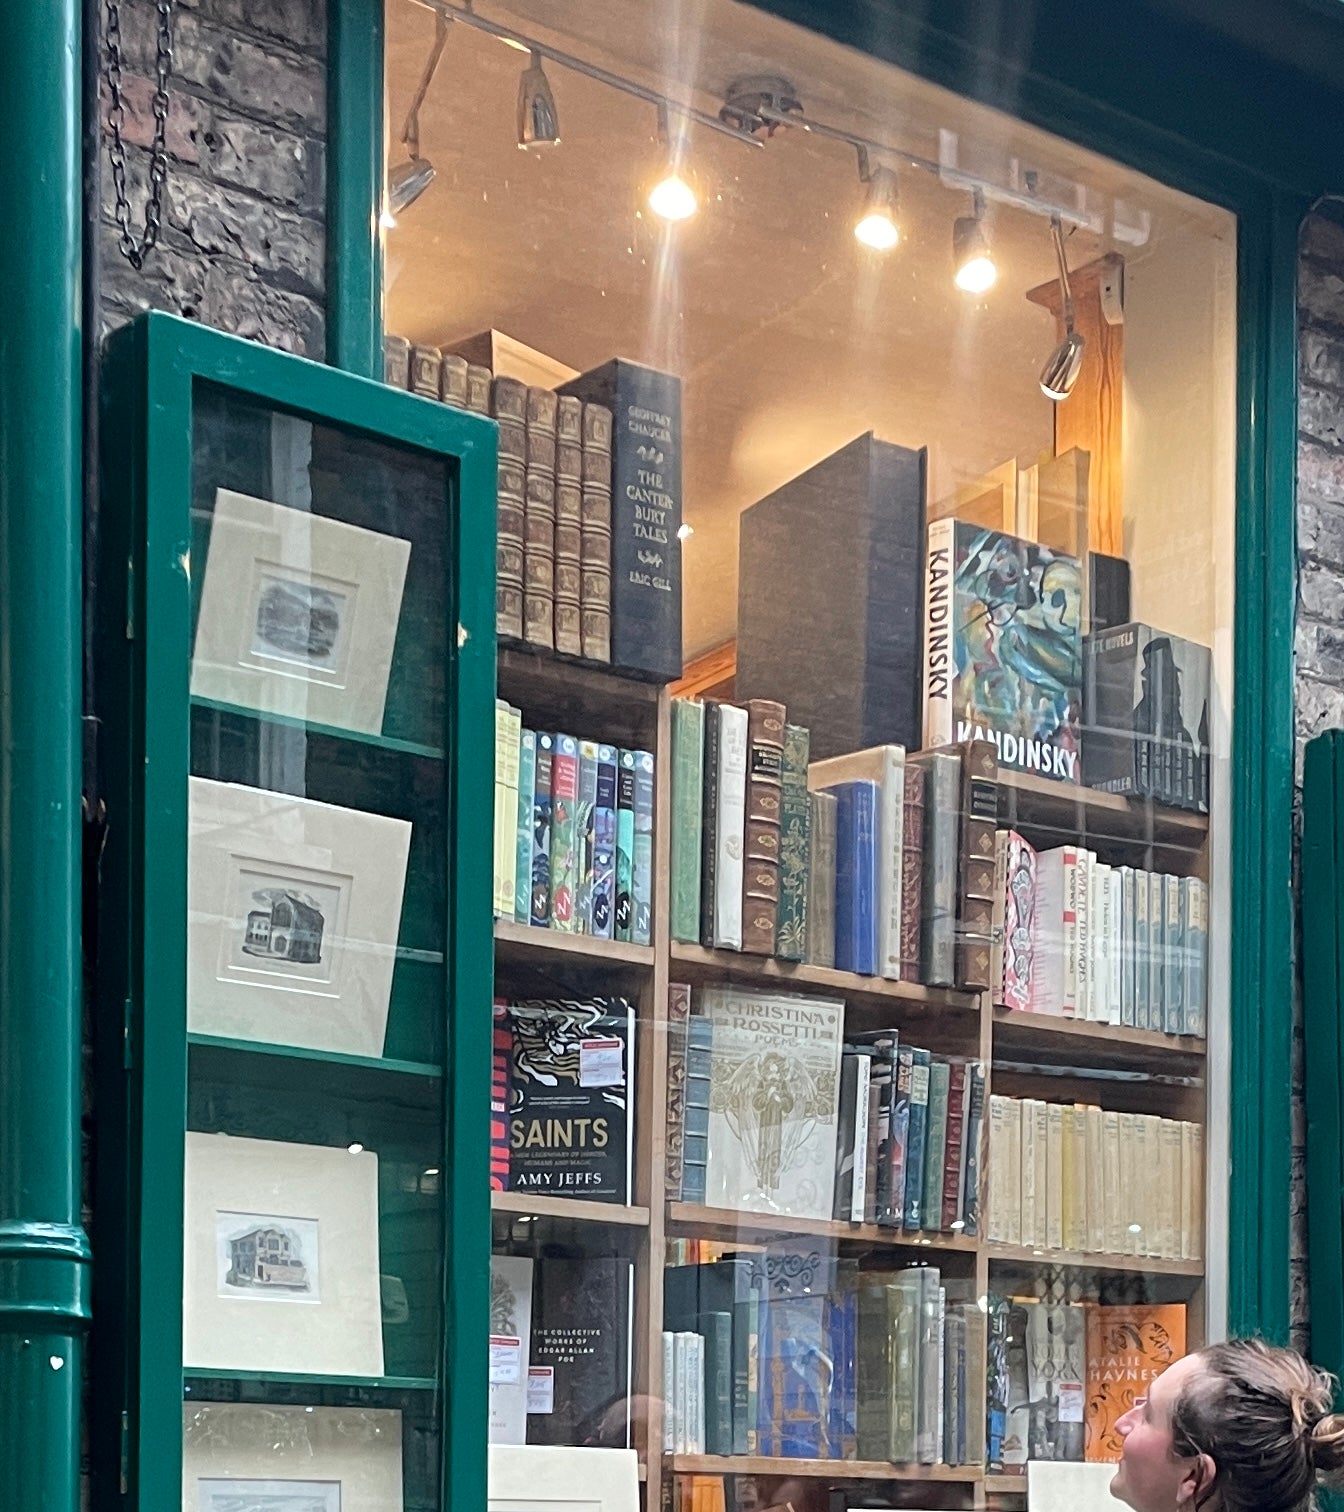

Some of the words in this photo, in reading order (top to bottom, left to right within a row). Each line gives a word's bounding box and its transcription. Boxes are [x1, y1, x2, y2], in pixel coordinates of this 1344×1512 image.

[638, 469, 663, 489] THE
[635, 505, 666, 525] BURY
[633, 524, 668, 544] TALES
[929, 548, 949, 700] KANDINSKY
[725, 1000, 825, 1026] CHRISTINA
[733, 1017, 819, 1040] ROSSETTI
[511, 1118, 608, 1149] SAINTS
[517, 1173, 552, 1185] AMY
[558, 1173, 602, 1187] JEFFS
[568, 1346, 594, 1354] ALLAN
[1090, 1369, 1158, 1381] HAYNES
